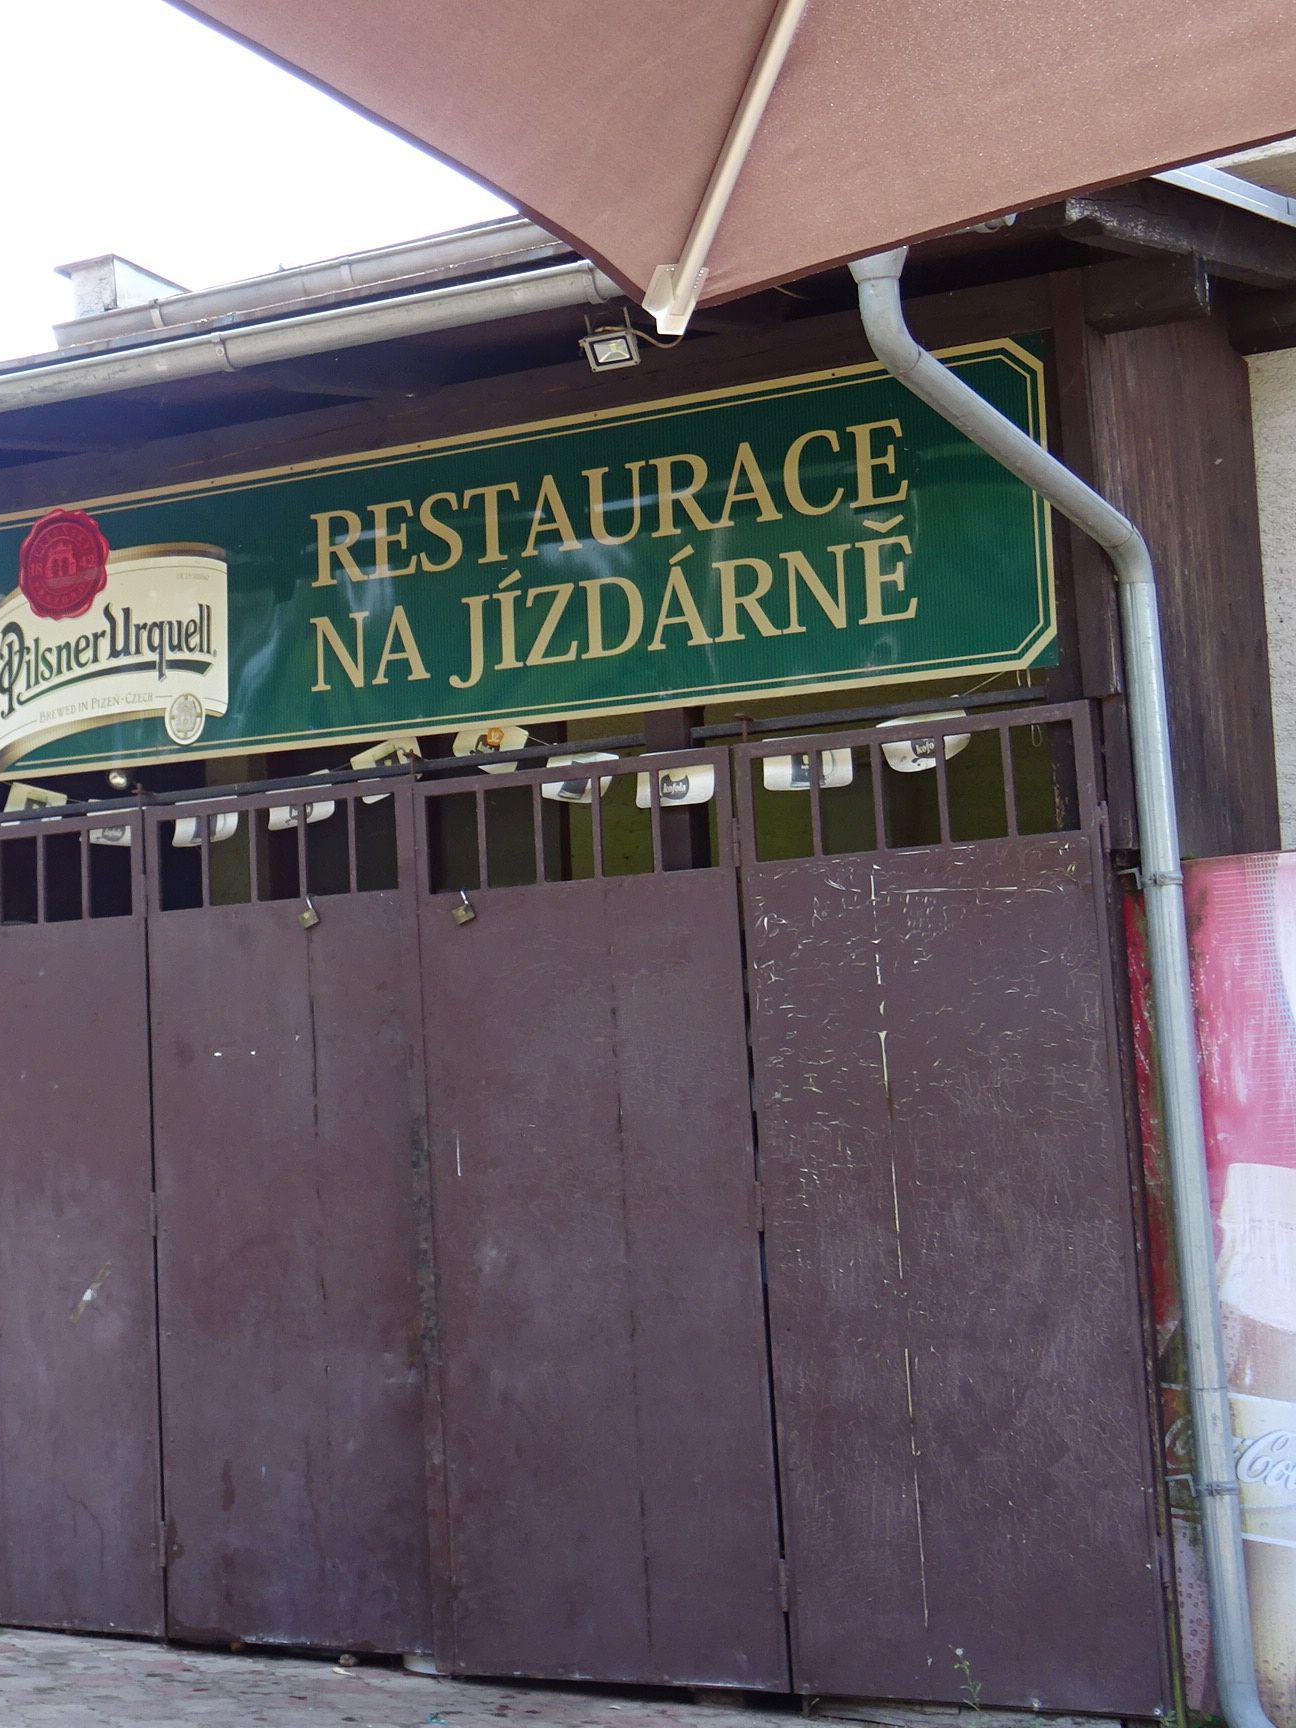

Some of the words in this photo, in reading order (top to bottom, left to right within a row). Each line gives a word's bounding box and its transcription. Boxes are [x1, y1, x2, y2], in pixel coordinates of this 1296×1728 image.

[310, 418, 908, 587] RESTAURACE
[103, 602, 213, 682] Urquell
[310, 605, 431, 692] NA
[448, 514, 918, 689] JÍZDÁRNĚ
[39, 704, 78, 723] BREWED
[78, 701, 89, 713] IN
